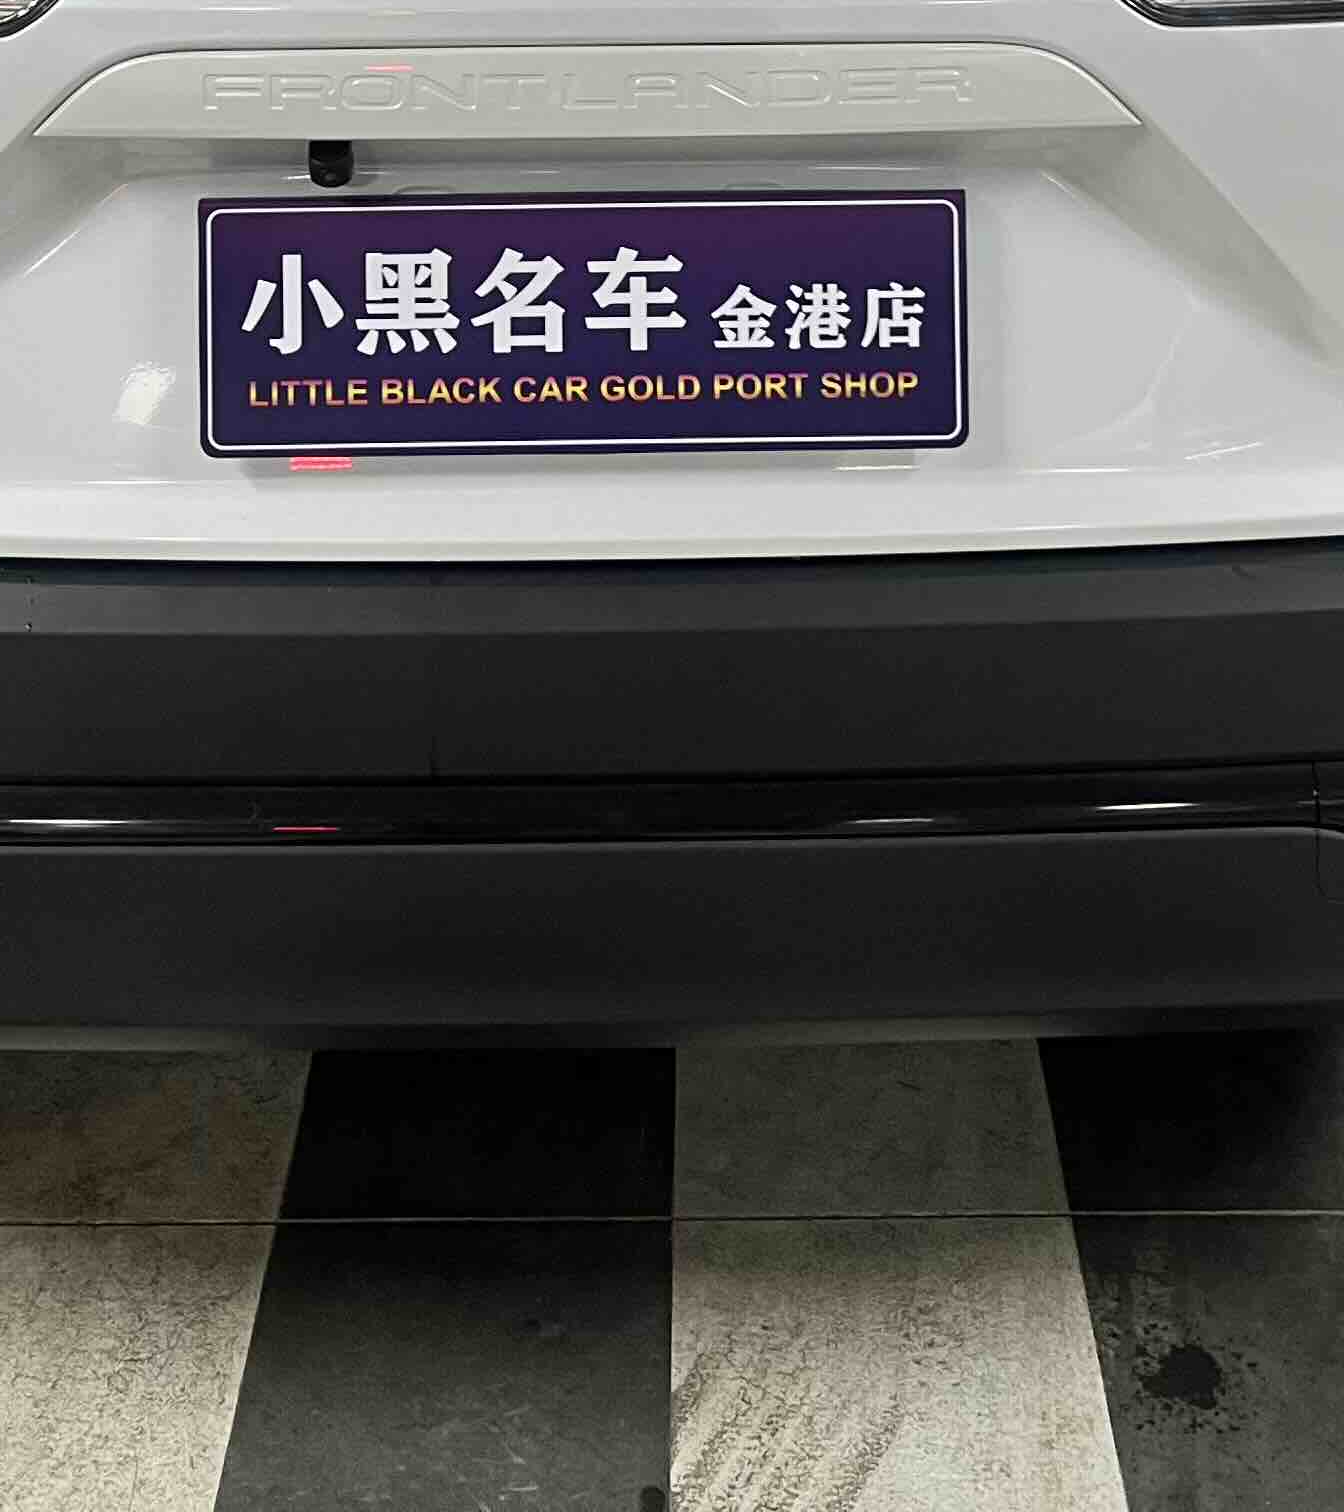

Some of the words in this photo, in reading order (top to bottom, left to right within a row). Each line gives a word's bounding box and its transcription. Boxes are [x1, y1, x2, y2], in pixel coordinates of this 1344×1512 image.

[204, 66, 975, 111] FRONTLANDER
[241, 247, 687, 355] 小黑名车
[710, 282, 926, 351] 金港店
[249, 379, 368, 407] LITTLE
[380, 377, 503, 405] BLACK
[513, 375, 588, 403] CAR
[600, 374, 701, 401] GOLD
[713, 373, 807, 400] PORT
[820, 371, 920, 398] SHOP
